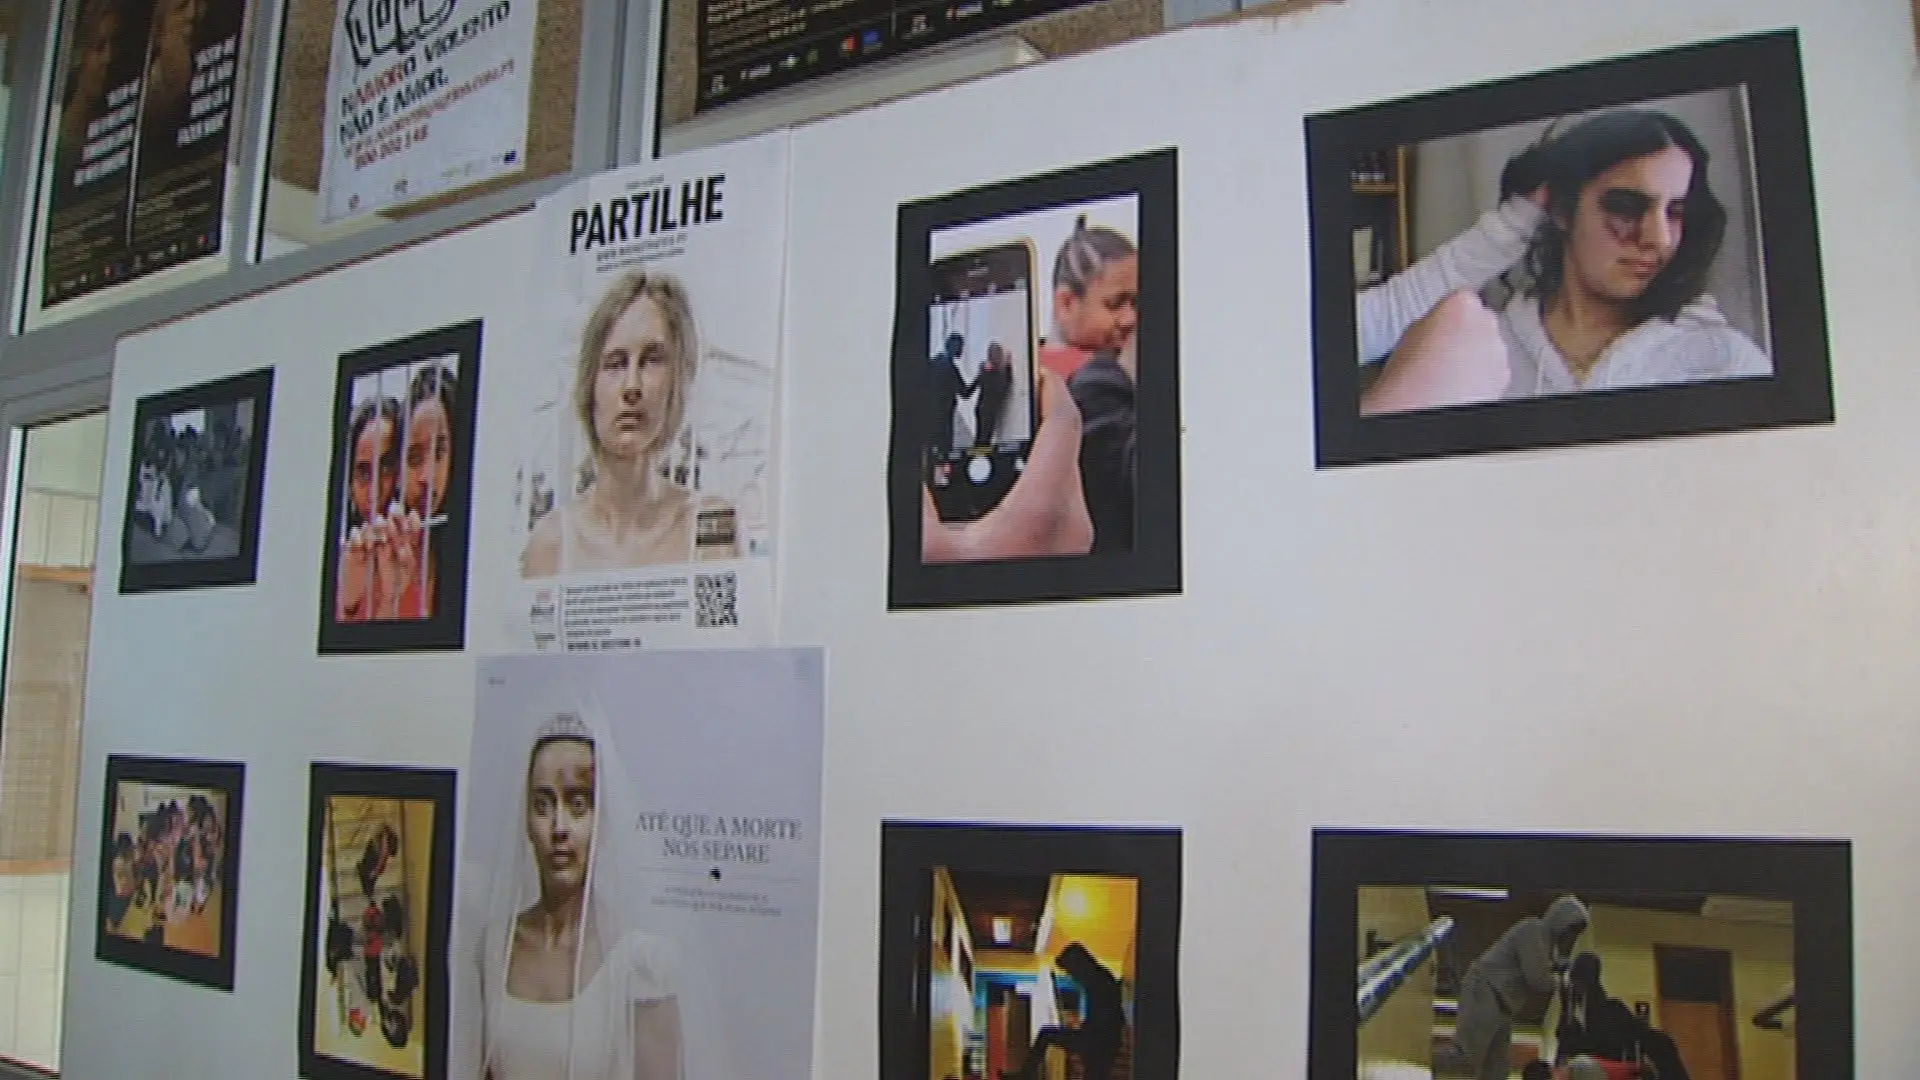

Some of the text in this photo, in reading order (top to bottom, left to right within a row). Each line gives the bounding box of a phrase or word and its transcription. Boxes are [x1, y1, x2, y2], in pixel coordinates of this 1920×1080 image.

[340, 55, 416, 116] NAMORO
[424, 0, 511, 62] VIOLENTO
[339, 106, 374, 146] NÃO
[377, 95, 390, 121] É
[394, 67, 449, 112] AMOR.
[570, 173, 725, 255] PARTILHE
[635, 809, 803, 840] ATÉ QUE A MORTE
[662, 837, 771, 863] NOS SEPARE
